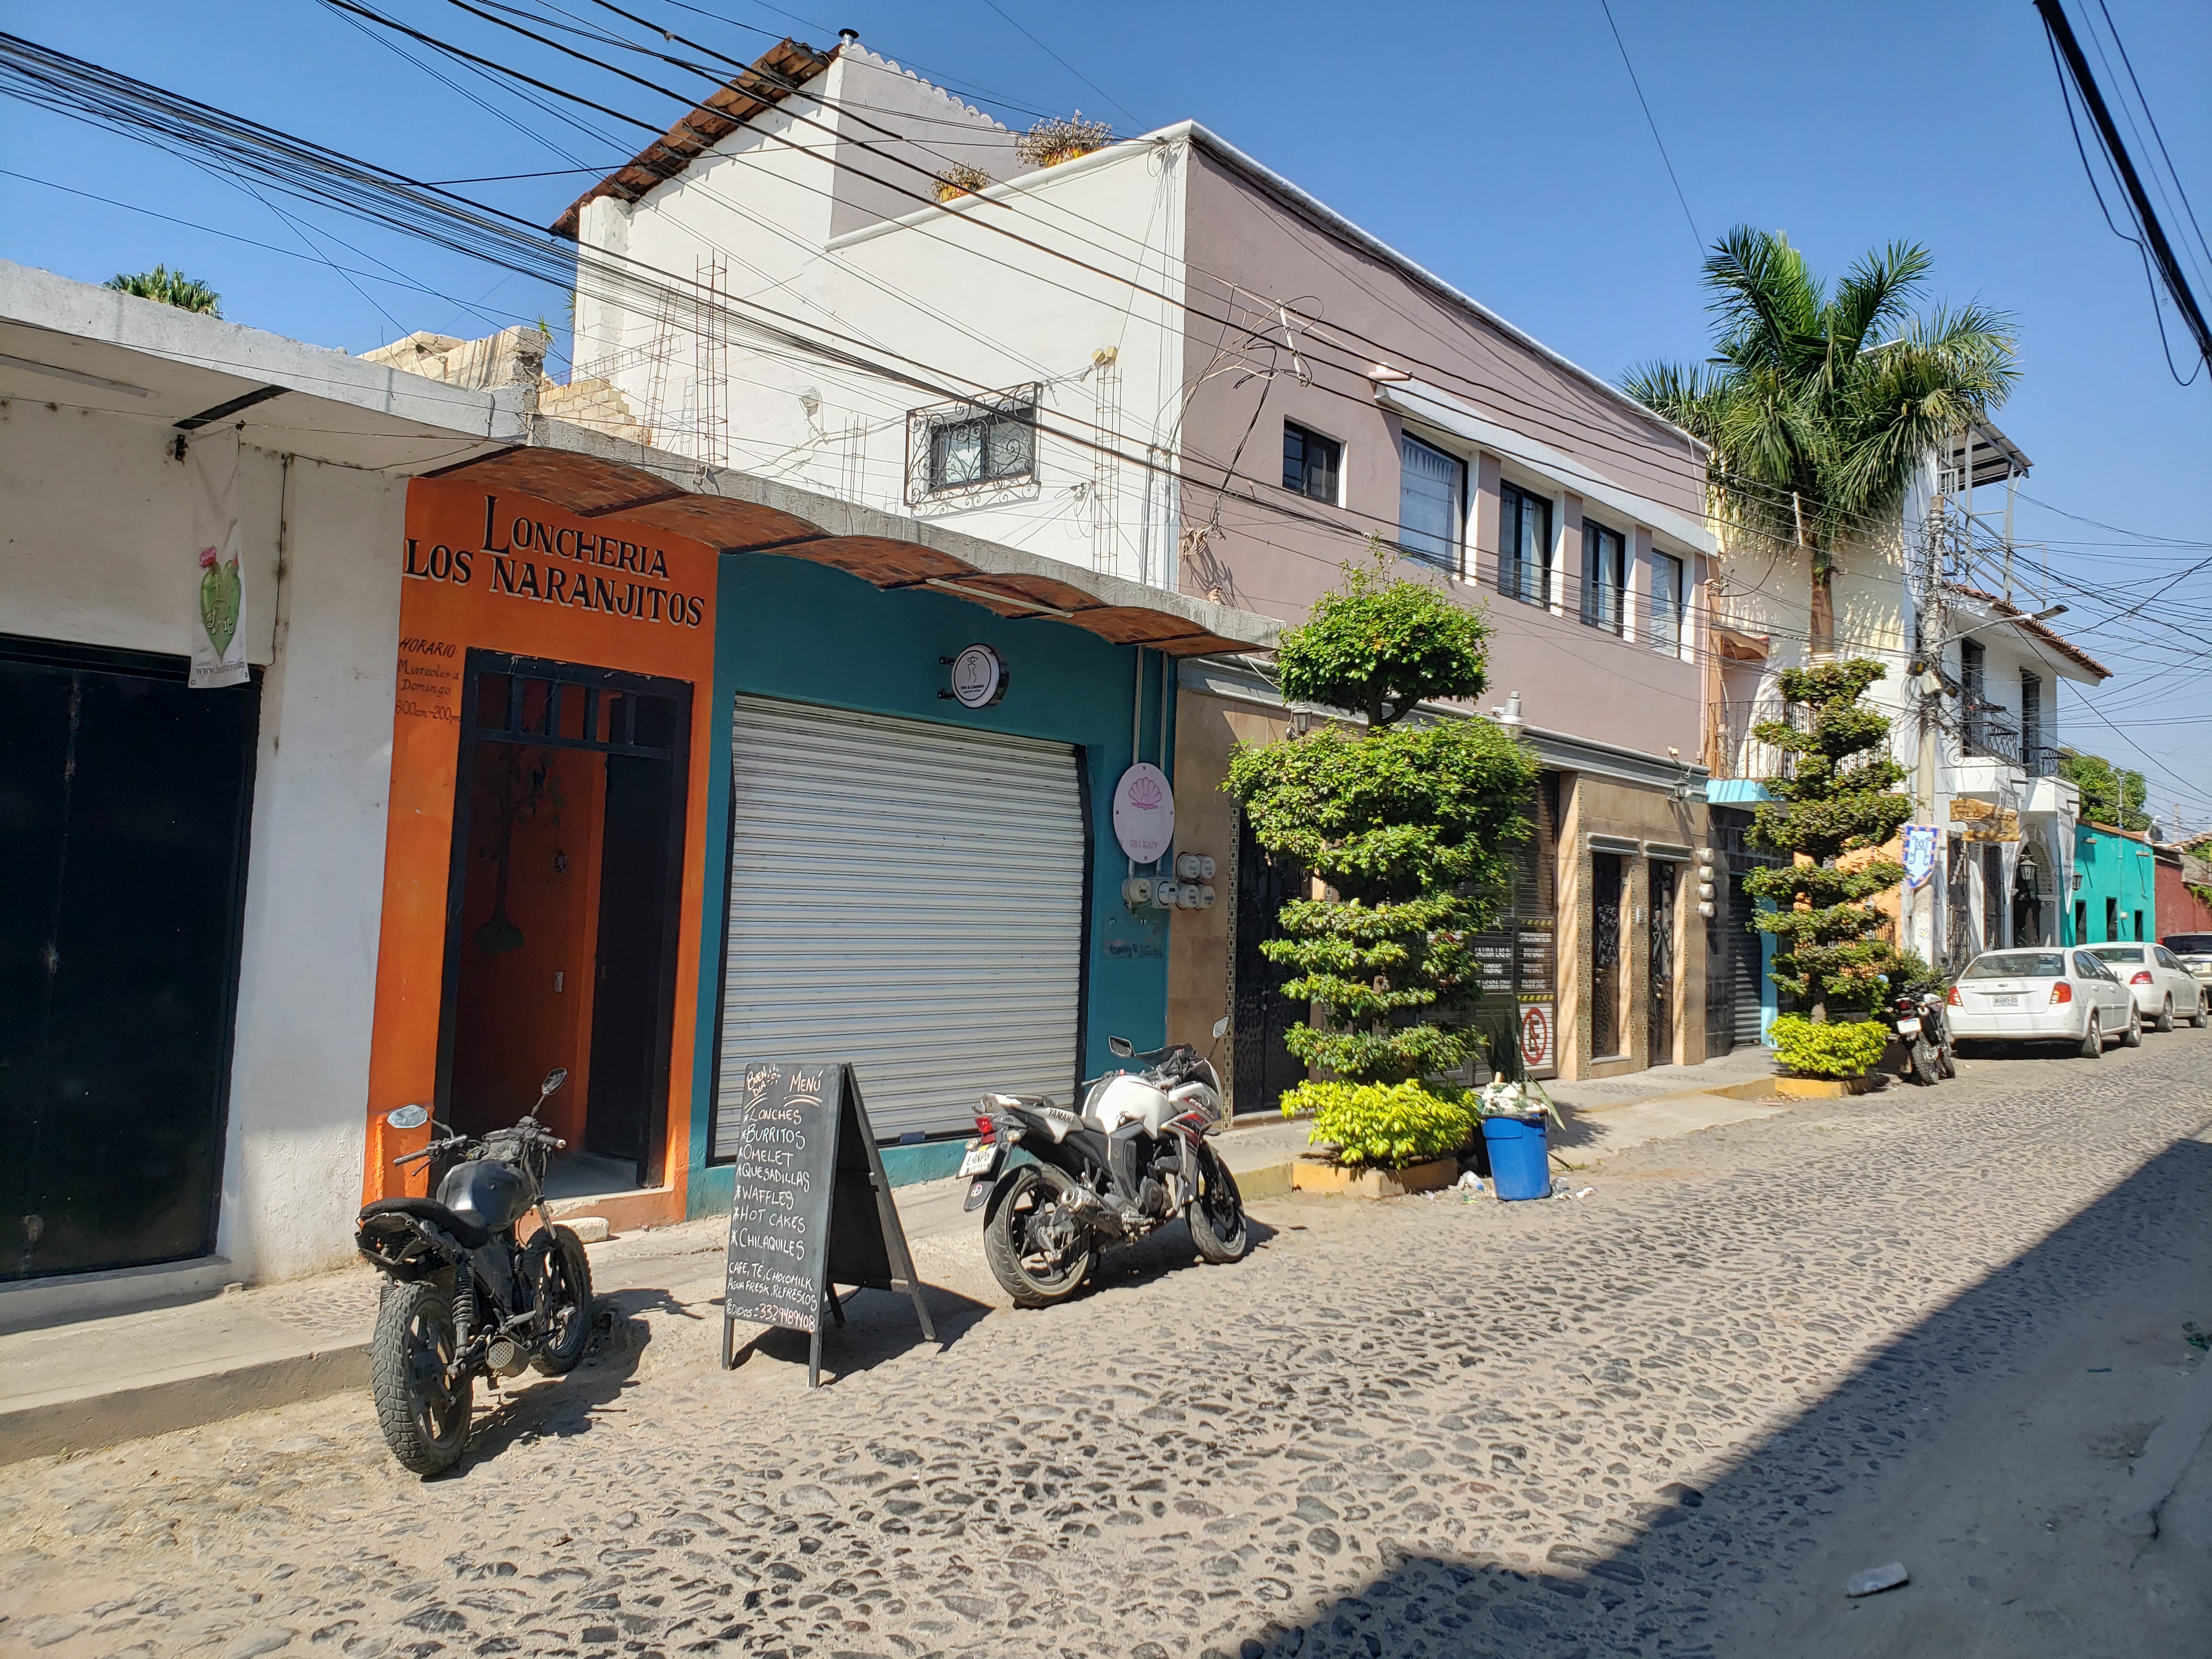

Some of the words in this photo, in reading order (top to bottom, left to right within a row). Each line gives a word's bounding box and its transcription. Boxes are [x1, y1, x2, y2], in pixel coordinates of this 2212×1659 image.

[479, 495, 670, 582] LONCHERIA
[402, 539, 473, 586] LOS
[489, 556, 704, 629] NARANJITOS
[399, 679, 452, 697] Domingo
[746, 1065, 767, 1091] BUEN
[789, 1069, 823, 1093] MENÚ
[749, 1107, 802, 1125] LONCHES
[746, 1124, 806, 1149] BURRITOS
[743, 1144, 794, 1167] OMELET
[742, 1163, 810, 1193] QUESADILLAS
[742, 1184, 794, 1210] WAFFLES
[740, 1204, 766, 1223] HOT
[769, 1214, 805, 1233] CAKES
[740, 1227, 805, 1260] CHILAQUILES
[727, 1277, 744, 1290] AGUA
